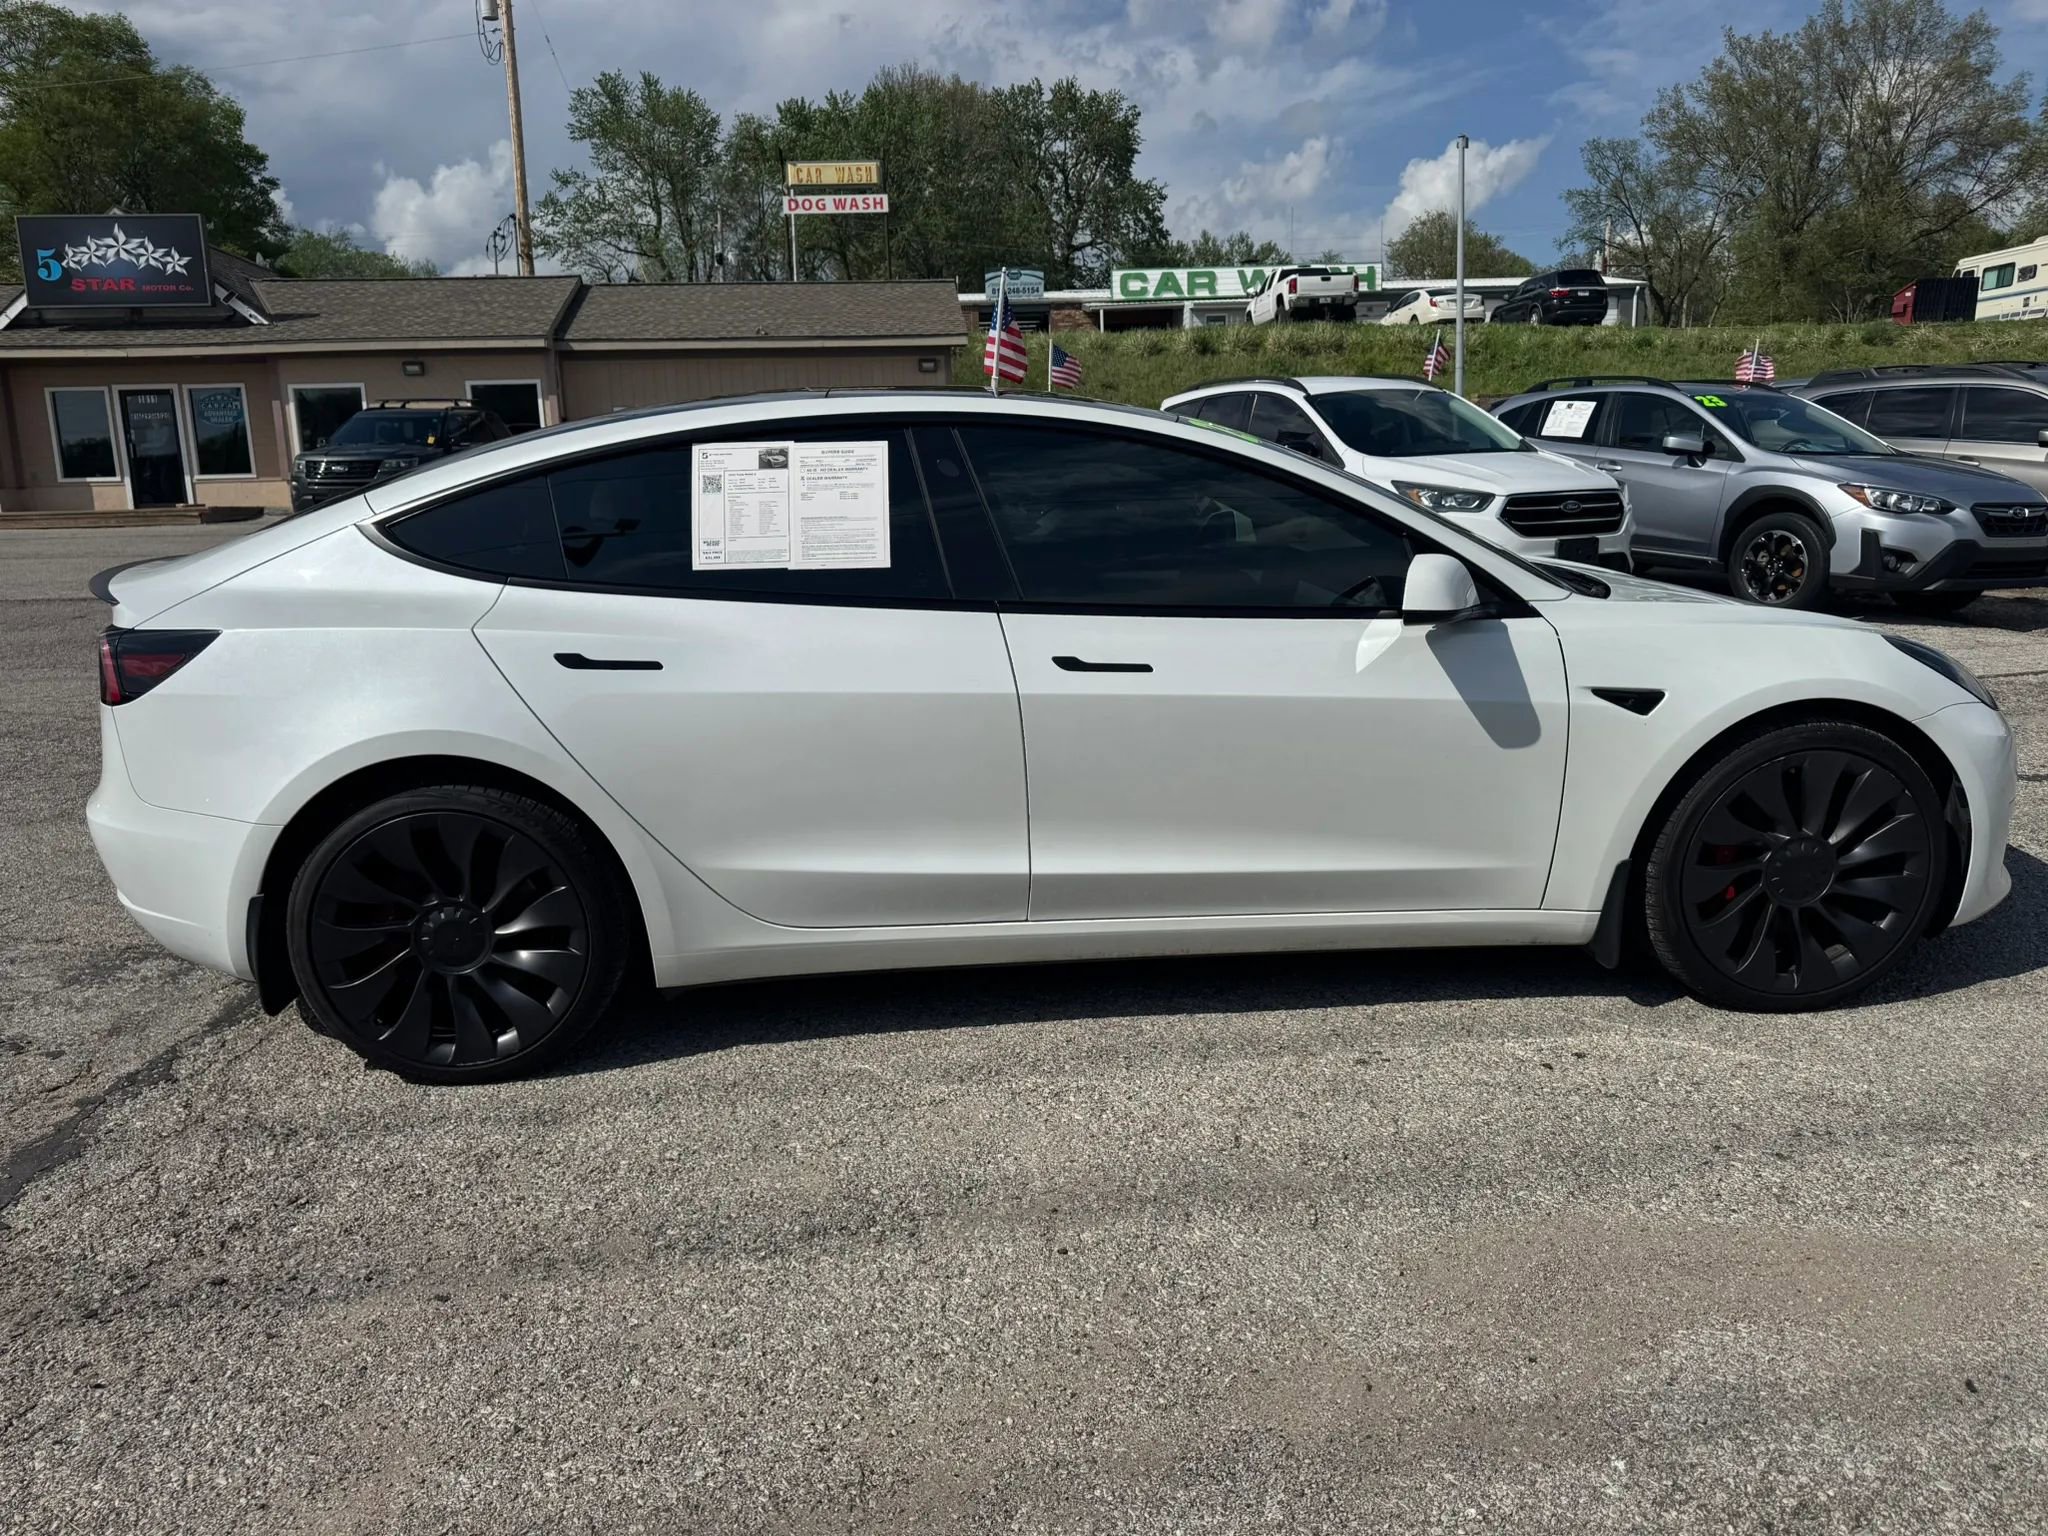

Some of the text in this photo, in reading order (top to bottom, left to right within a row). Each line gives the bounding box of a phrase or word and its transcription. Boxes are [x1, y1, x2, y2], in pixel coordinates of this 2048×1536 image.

[796, 166, 873, 183] CAR WASH
[787, 197, 884, 212] DOG WASH
[36, 248, 63, 281] 5
[71, 278, 137, 292] STAR
[1119, 266, 1377, 297] CAR WH
[1694, 395, 1728, 407] 23
